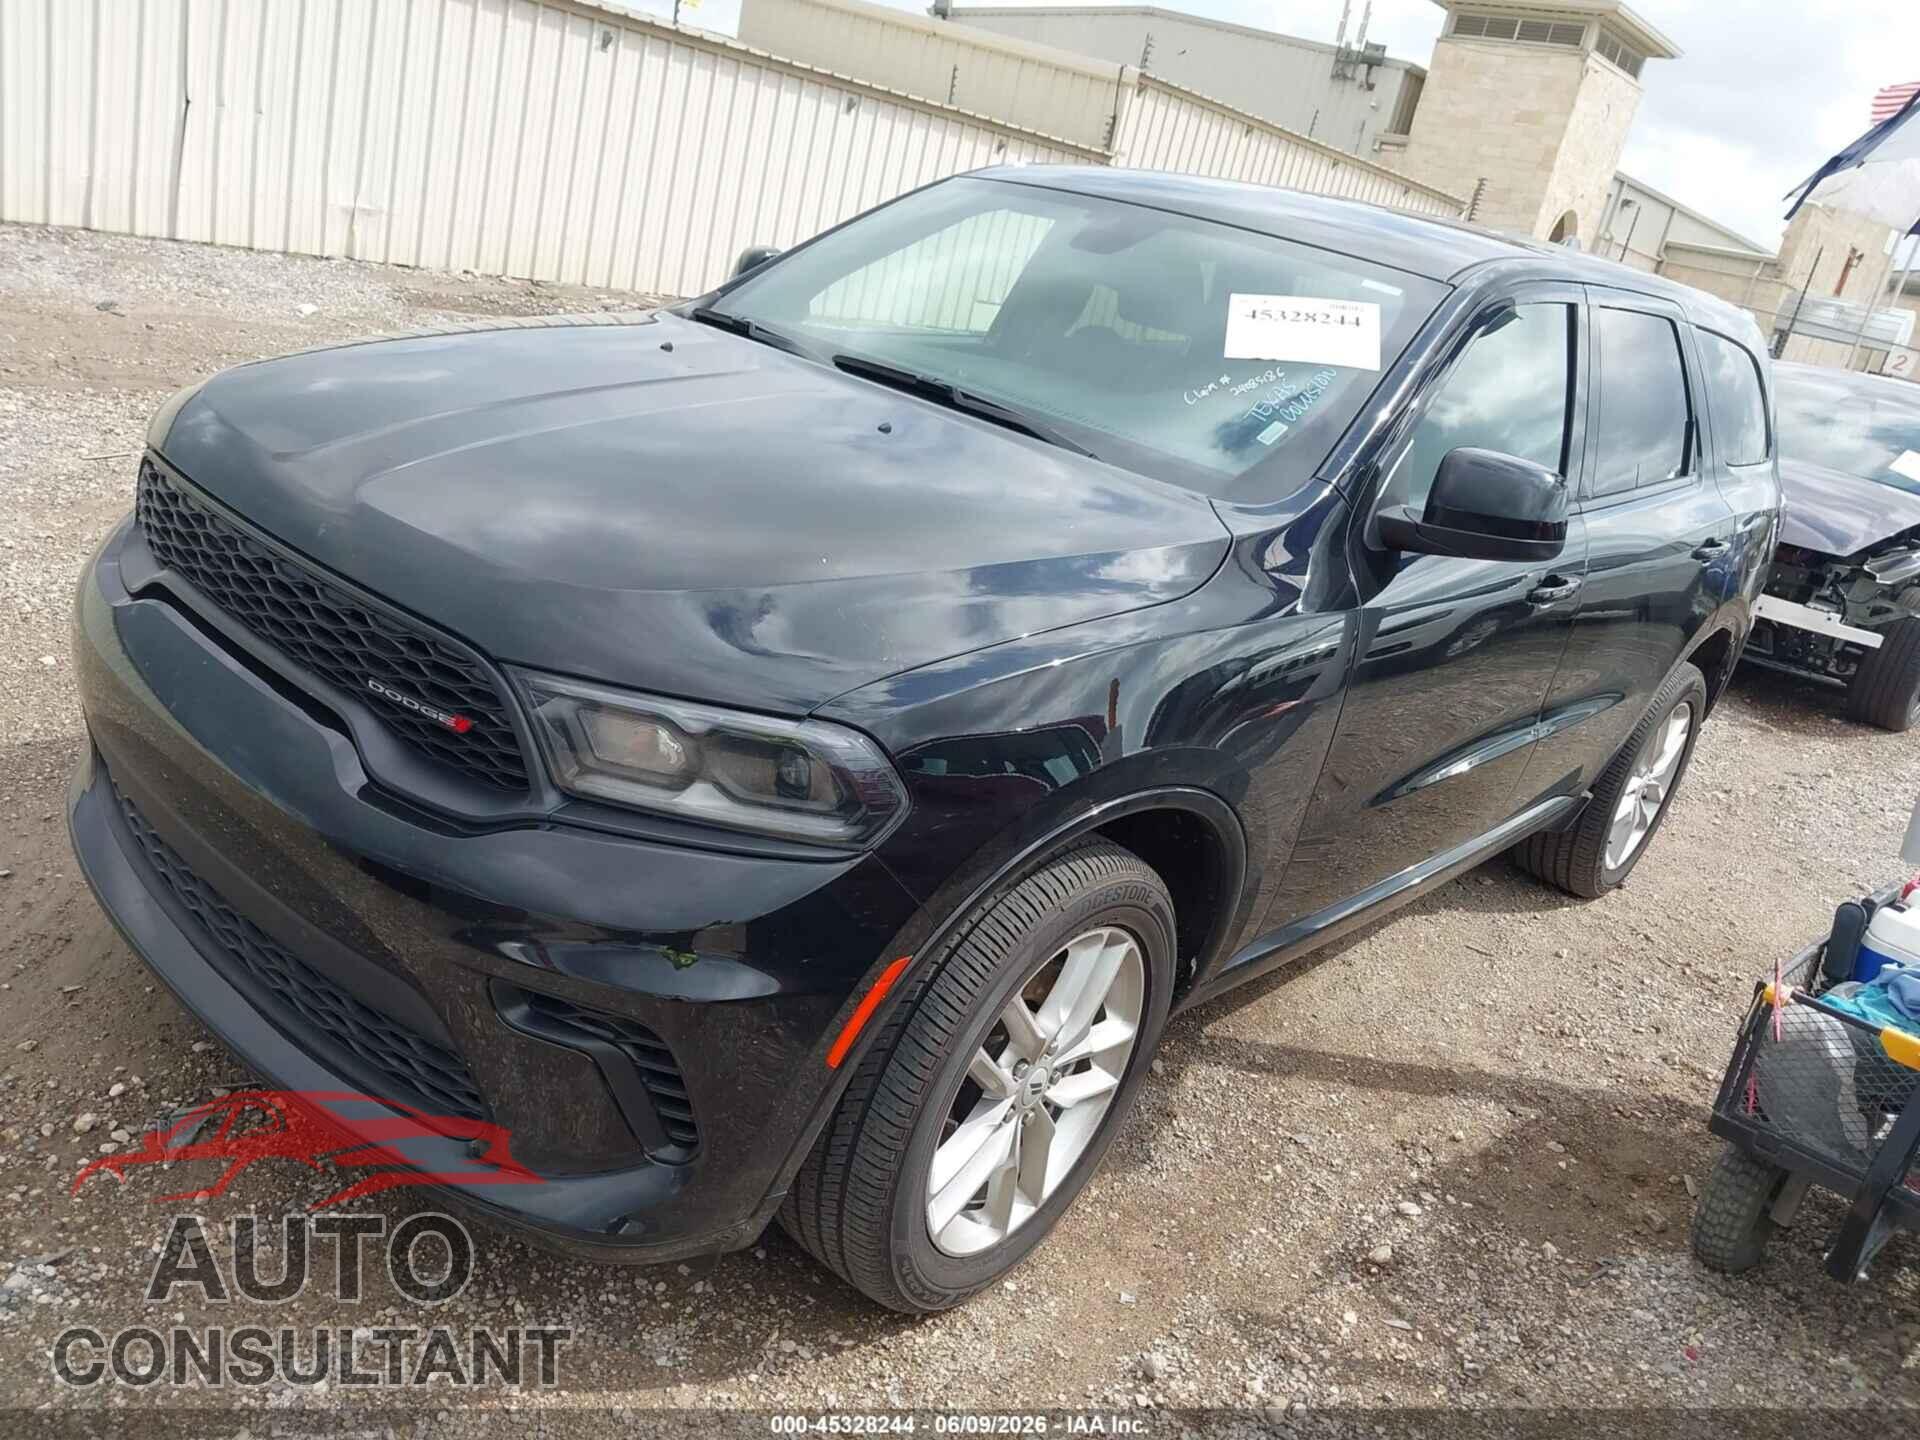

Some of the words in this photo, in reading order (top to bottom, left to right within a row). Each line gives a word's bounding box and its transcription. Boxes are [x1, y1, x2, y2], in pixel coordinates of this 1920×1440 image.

[1244, 309, 1361, 328] 45328244
[1892, 354, 1908, 371] 2
[368, 679, 456, 727] DODGE
